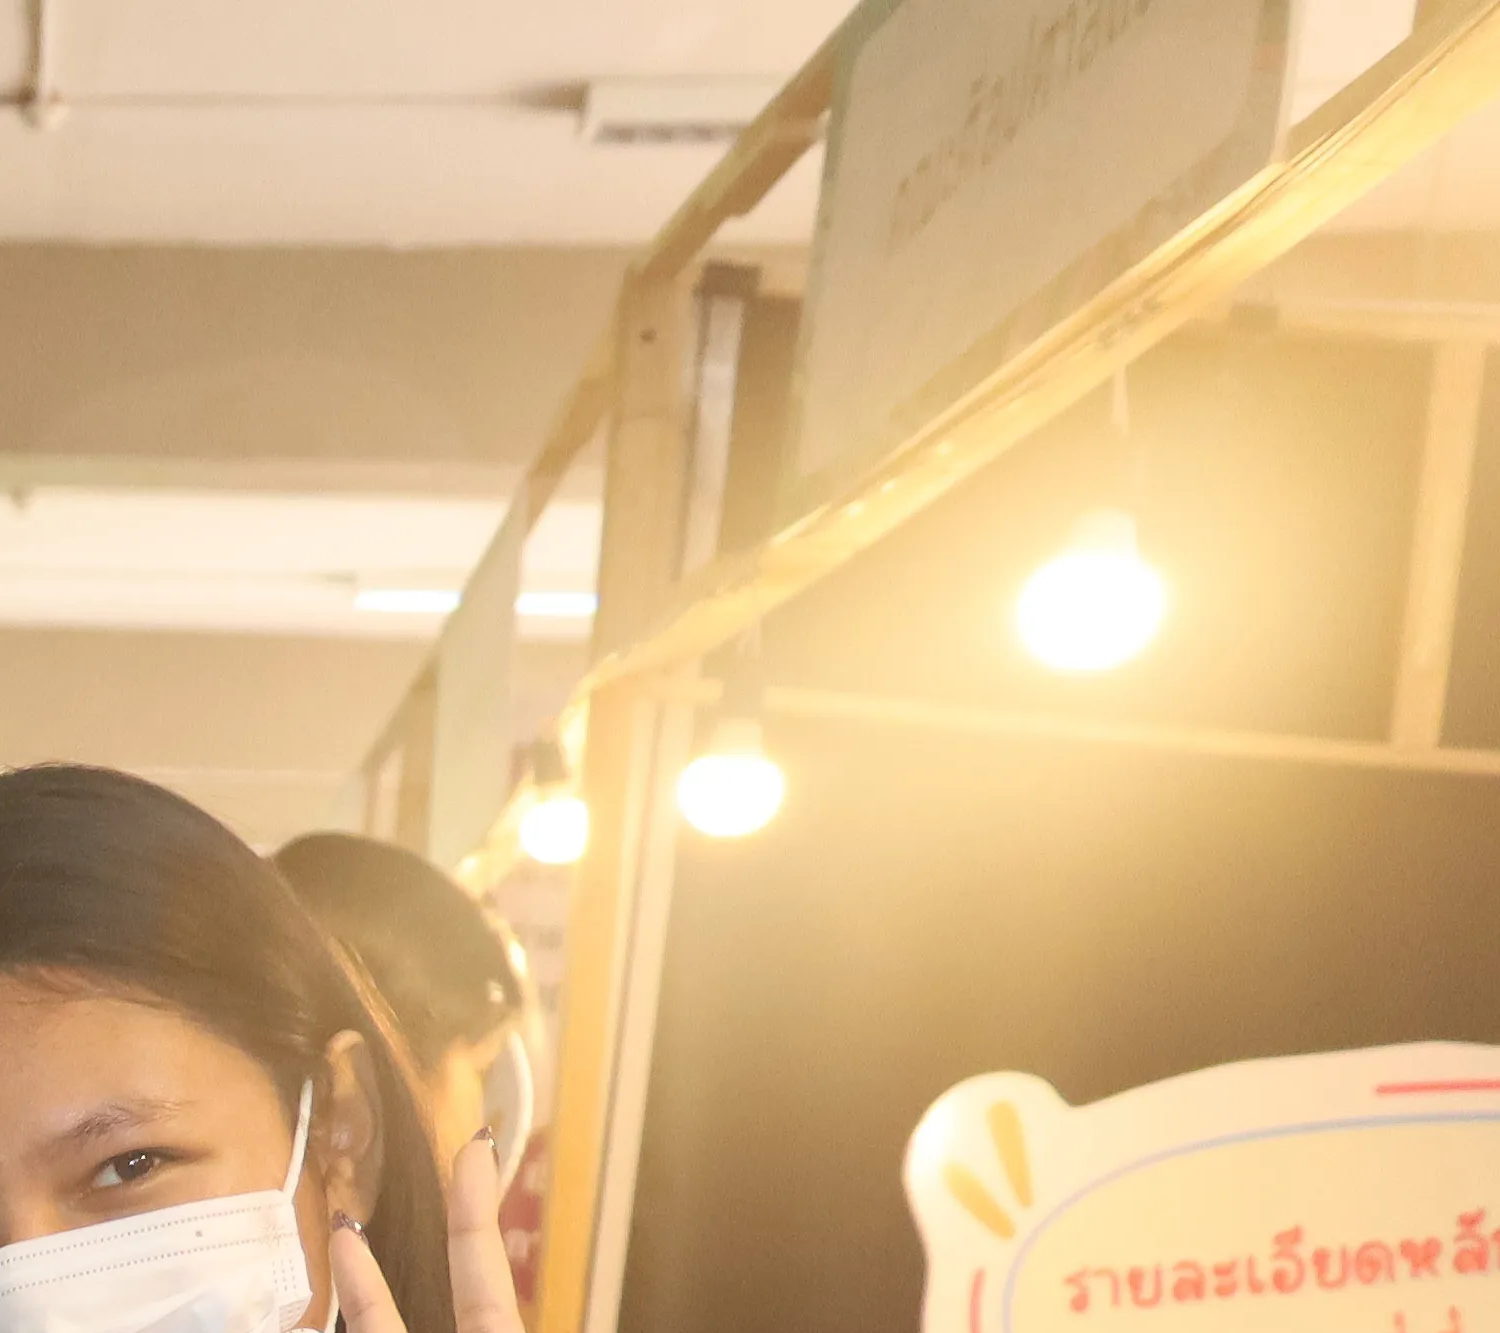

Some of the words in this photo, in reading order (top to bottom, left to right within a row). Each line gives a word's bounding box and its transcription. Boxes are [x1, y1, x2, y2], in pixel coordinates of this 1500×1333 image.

[1063, 1207, 1500, 1314] รายละเอียดหลั
